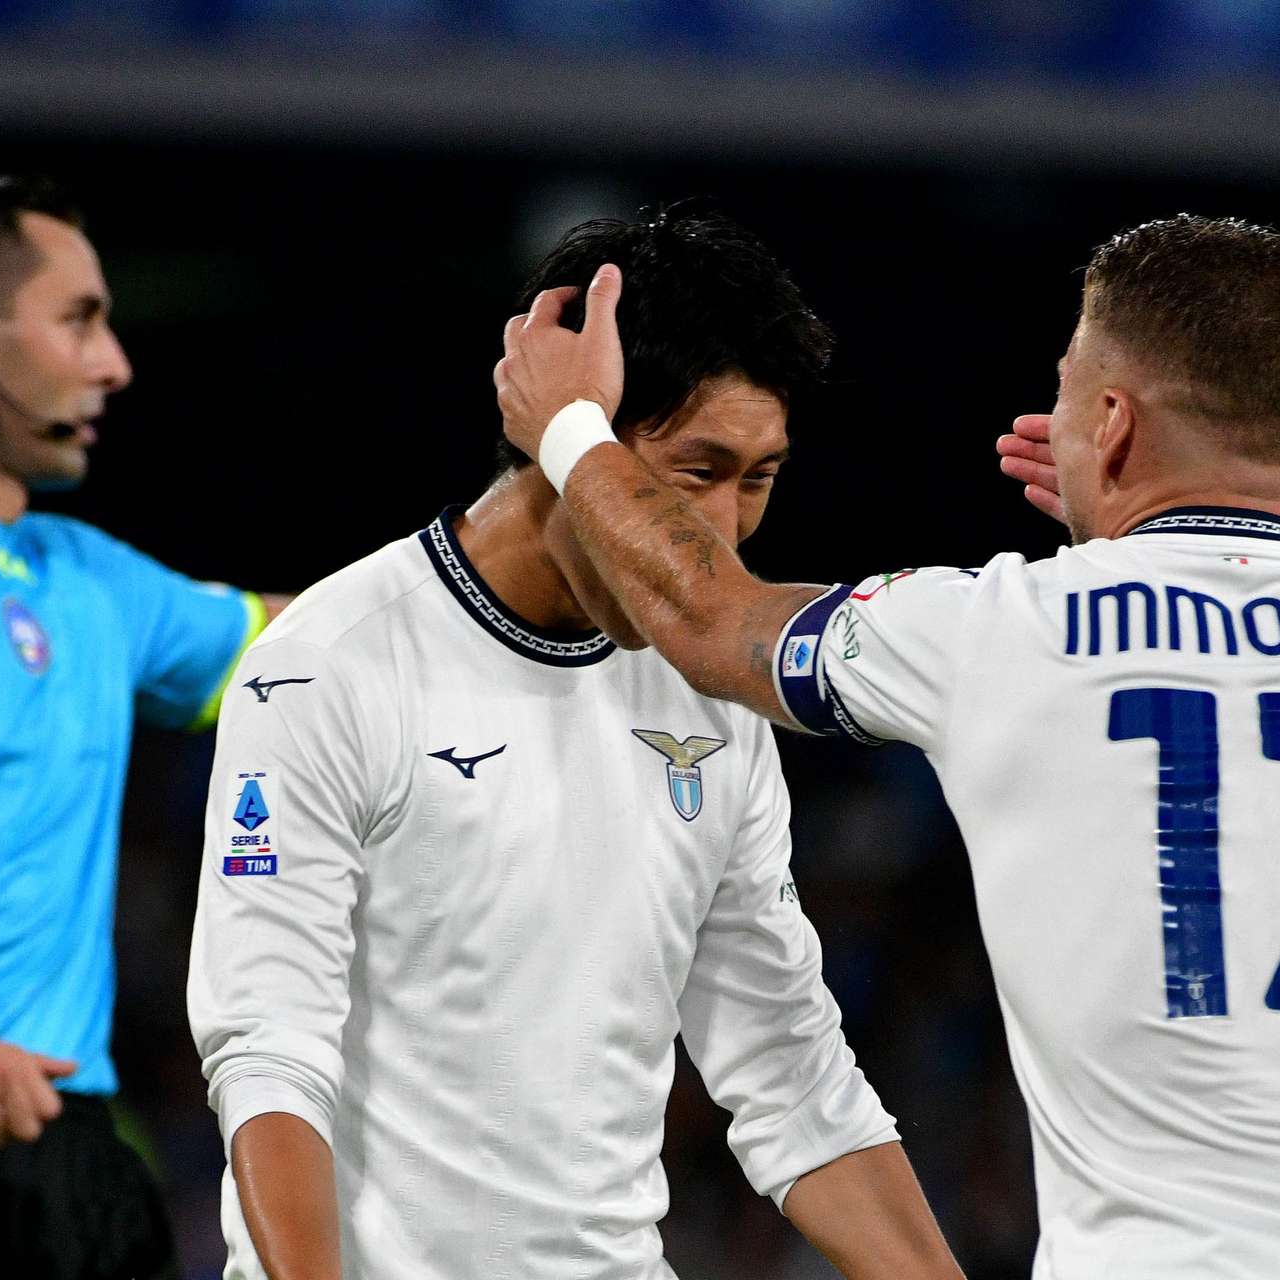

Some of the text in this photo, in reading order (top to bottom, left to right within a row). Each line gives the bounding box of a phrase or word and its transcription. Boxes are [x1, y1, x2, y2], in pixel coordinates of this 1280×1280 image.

[231, 835, 271, 846] SERIE A
[246, 859, 272, 873] TIM
